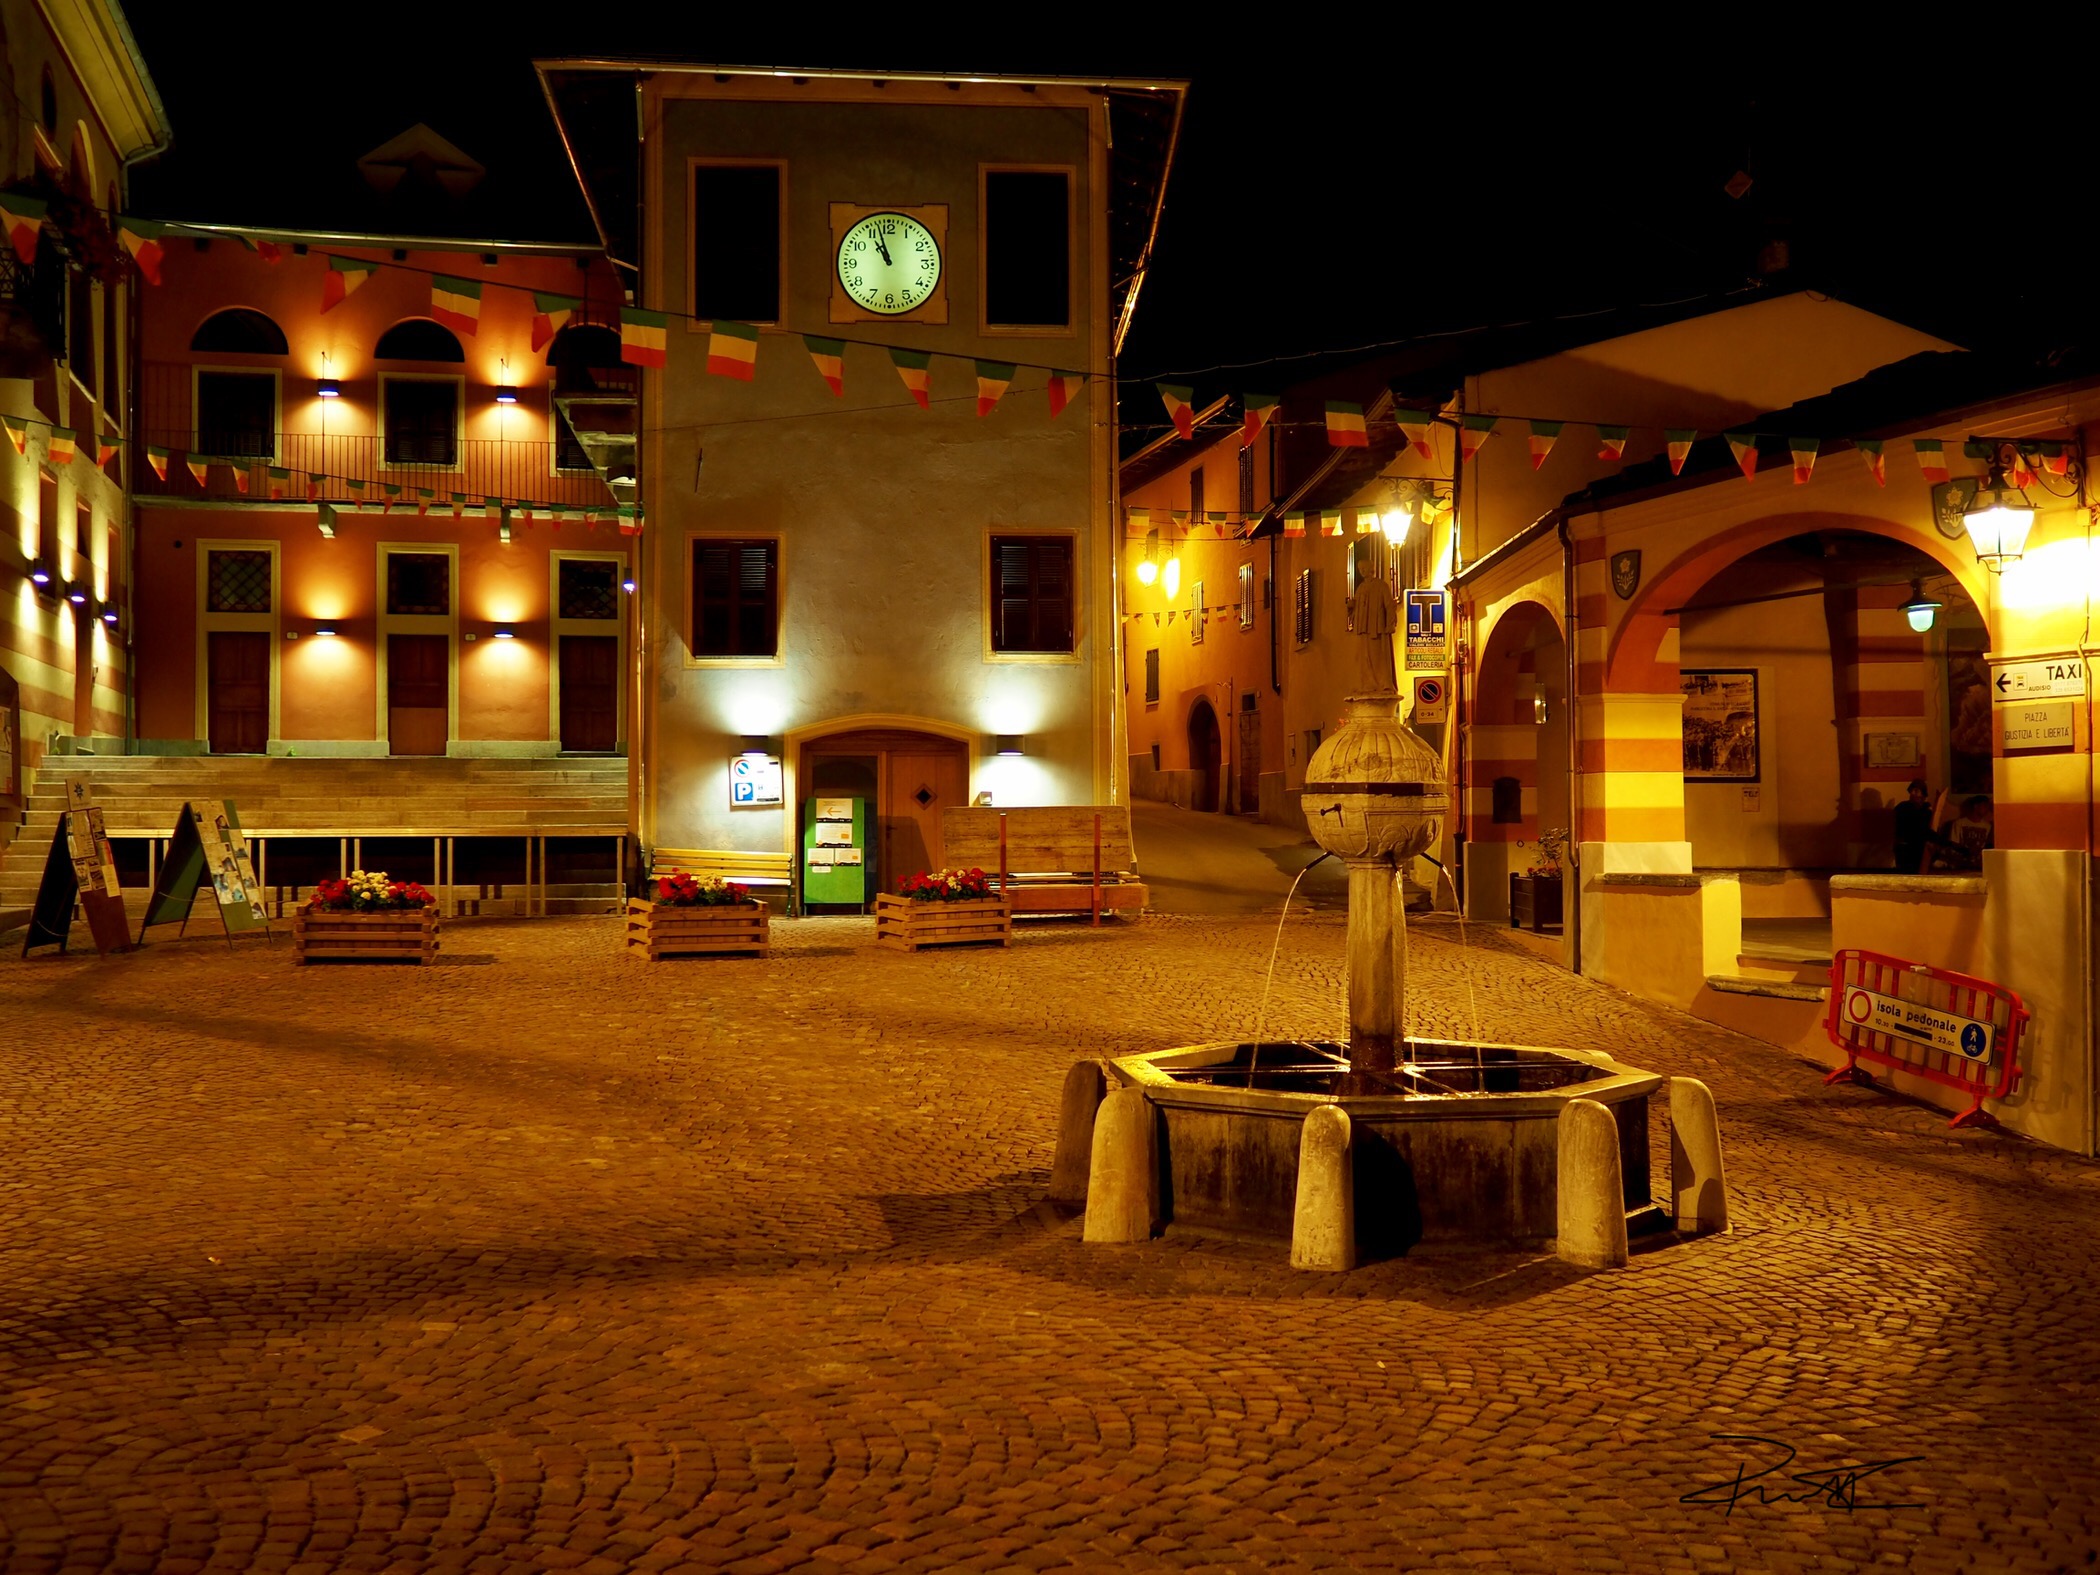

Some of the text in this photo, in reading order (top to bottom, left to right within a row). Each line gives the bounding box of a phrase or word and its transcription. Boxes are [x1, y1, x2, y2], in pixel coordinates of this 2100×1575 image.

[868, 228, 876, 239] 11
[882, 224, 896, 235] 12
[854, 241, 866, 251] 10
[915, 241, 924, 252] 2
[848, 258, 857, 269] 9
[920, 259, 930, 270] 3
[854, 276, 863, 287] 8
[915, 276, 924, 287] 4
[869, 288, 878, 299] 7
[884, 293, 894, 304] 6
[901, 289, 911, 300] 5
[1410, 594, 1442, 633] T
[2046, 664, 2082, 680] TAXI
[2024, 711, 2048, 722] PIAZZA
[2004, 729, 2032, 740] GIUSTIZIA
[2035, 728, 2040, 739] E
[737, 783, 752, 800] P
[1877, 1001, 1957, 1033] isola pedonale
